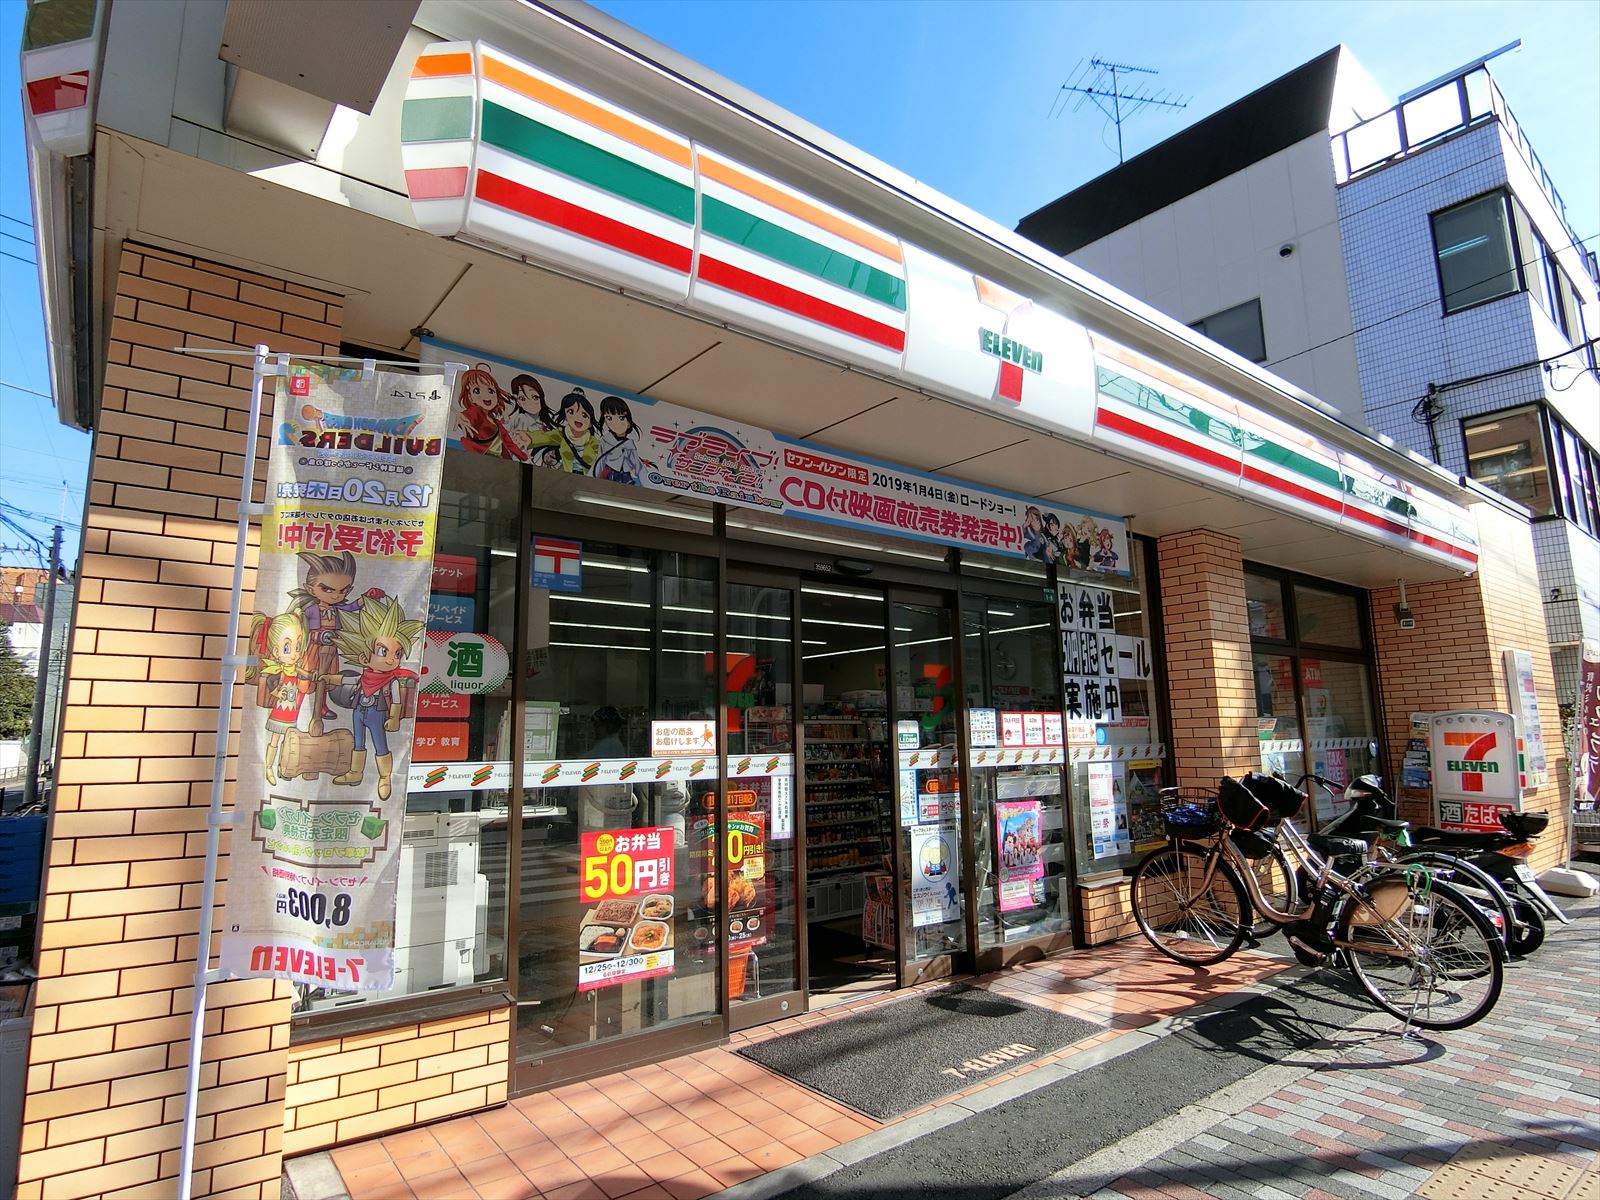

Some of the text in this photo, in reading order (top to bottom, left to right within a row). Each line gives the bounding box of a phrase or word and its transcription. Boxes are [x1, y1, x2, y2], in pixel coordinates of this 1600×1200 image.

[779, 475, 1024, 551] CD付映画前売券発売中!
[428, 604, 467, 616] リペイド
[1060, 586, 1114, 630] お弁当
[428, 614, 463, 625] サービス
[446, 641, 485, 678] 酒
[1305, 666, 1321, 680] ATM
[450, 680, 484, 691] liquor
[421, 699, 459, 709] サービス
[1064, 678, 1119, 721] 実施中
[655, 727, 694, 737] お店の商品
[416, 736, 461, 747] 学び 教育
[1440, 802, 1461, 822] 酒
[615, 832, 661, 853] お弁当
